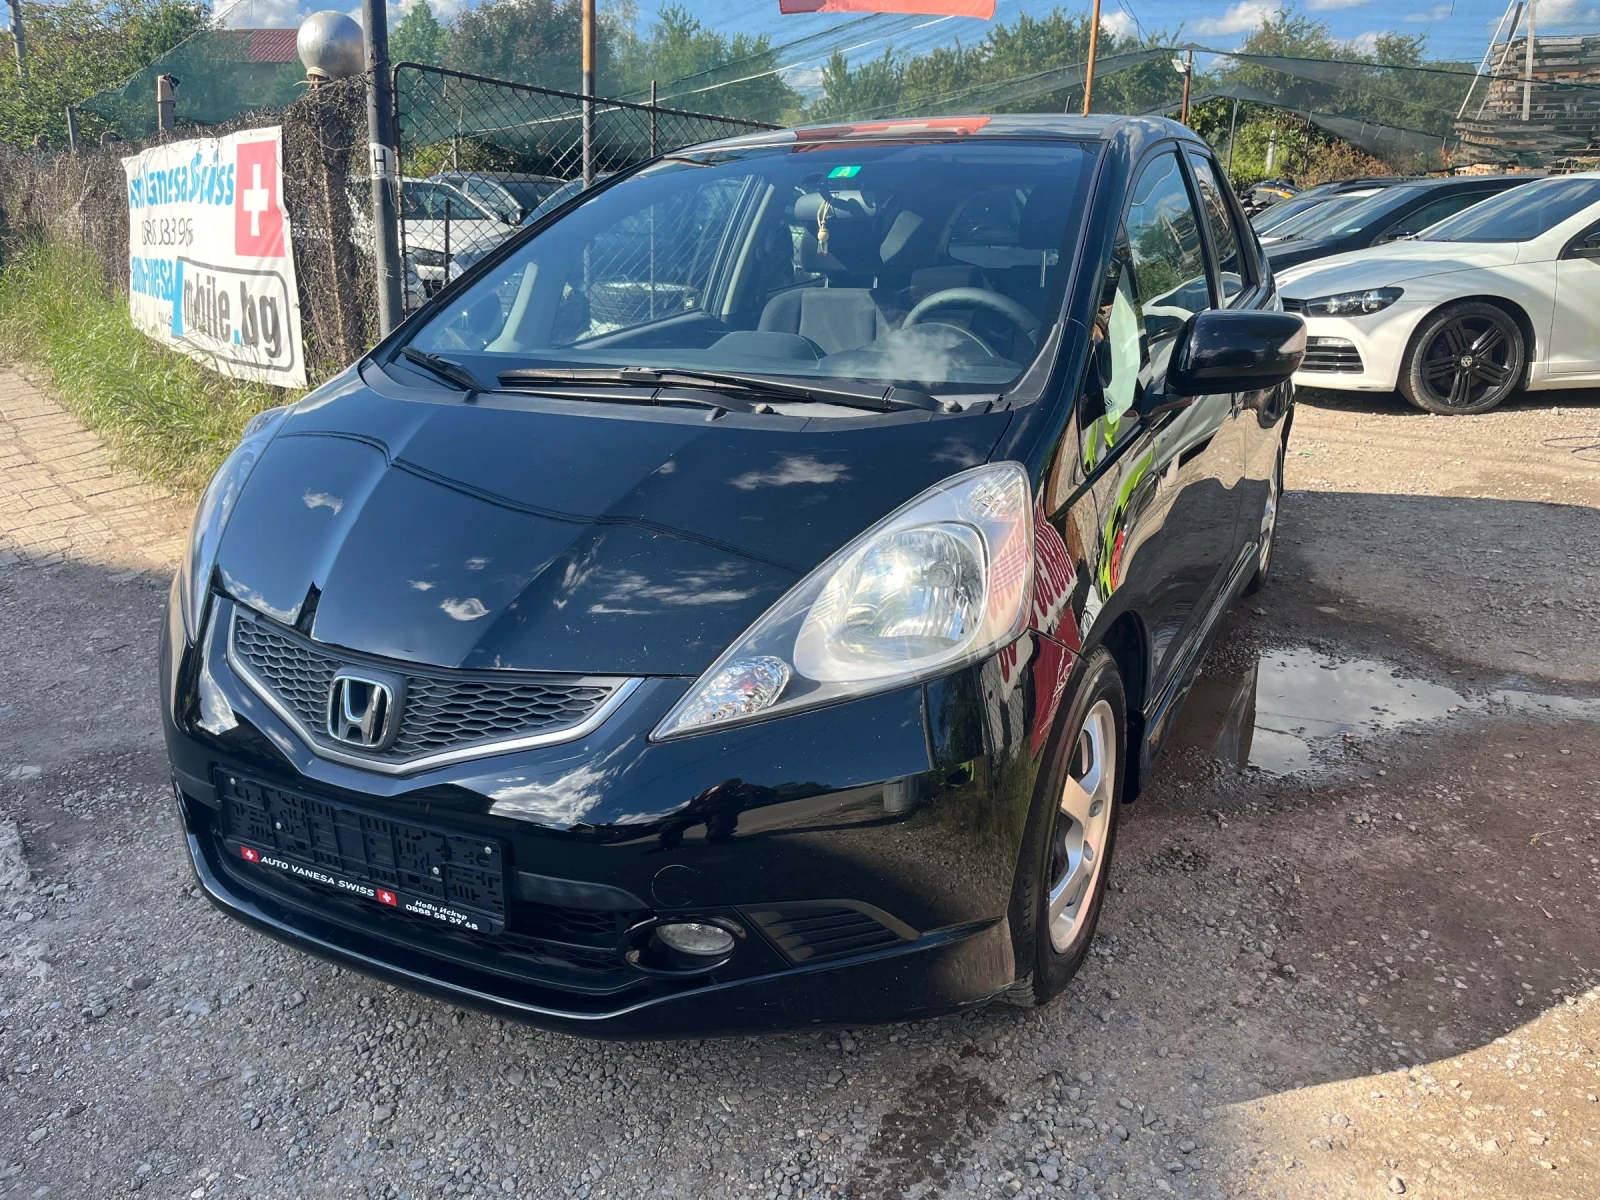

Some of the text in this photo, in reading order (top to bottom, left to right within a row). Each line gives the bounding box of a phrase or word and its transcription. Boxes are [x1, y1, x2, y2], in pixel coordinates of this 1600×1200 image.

[260, 856, 375, 897] AUTO VANESA SWISS
[405, 904, 479, 930] 0888 58 39 68
[415, 900, 468, 921] Нови Искър
